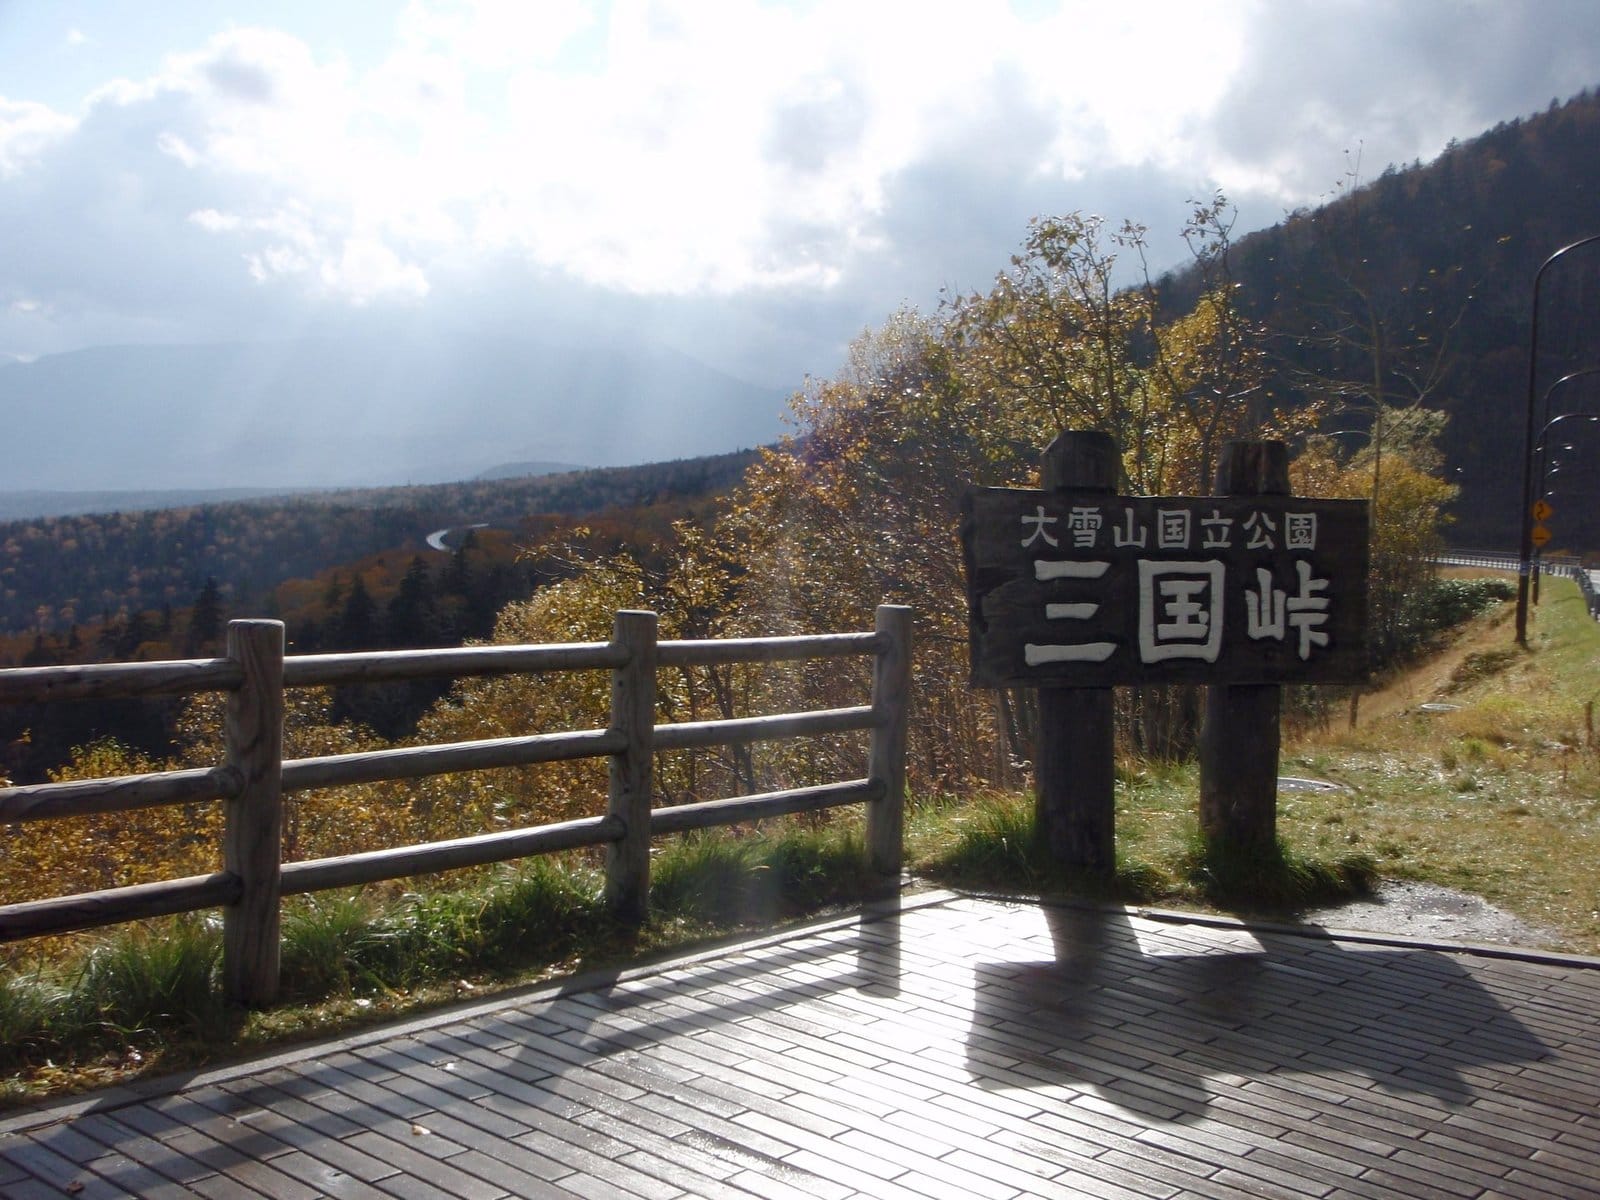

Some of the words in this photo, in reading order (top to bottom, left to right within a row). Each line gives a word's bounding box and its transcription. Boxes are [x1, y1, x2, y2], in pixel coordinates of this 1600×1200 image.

[1021, 505, 1318, 551] 大雪山国立公園
[1024, 559, 1331, 666] 三国峠
